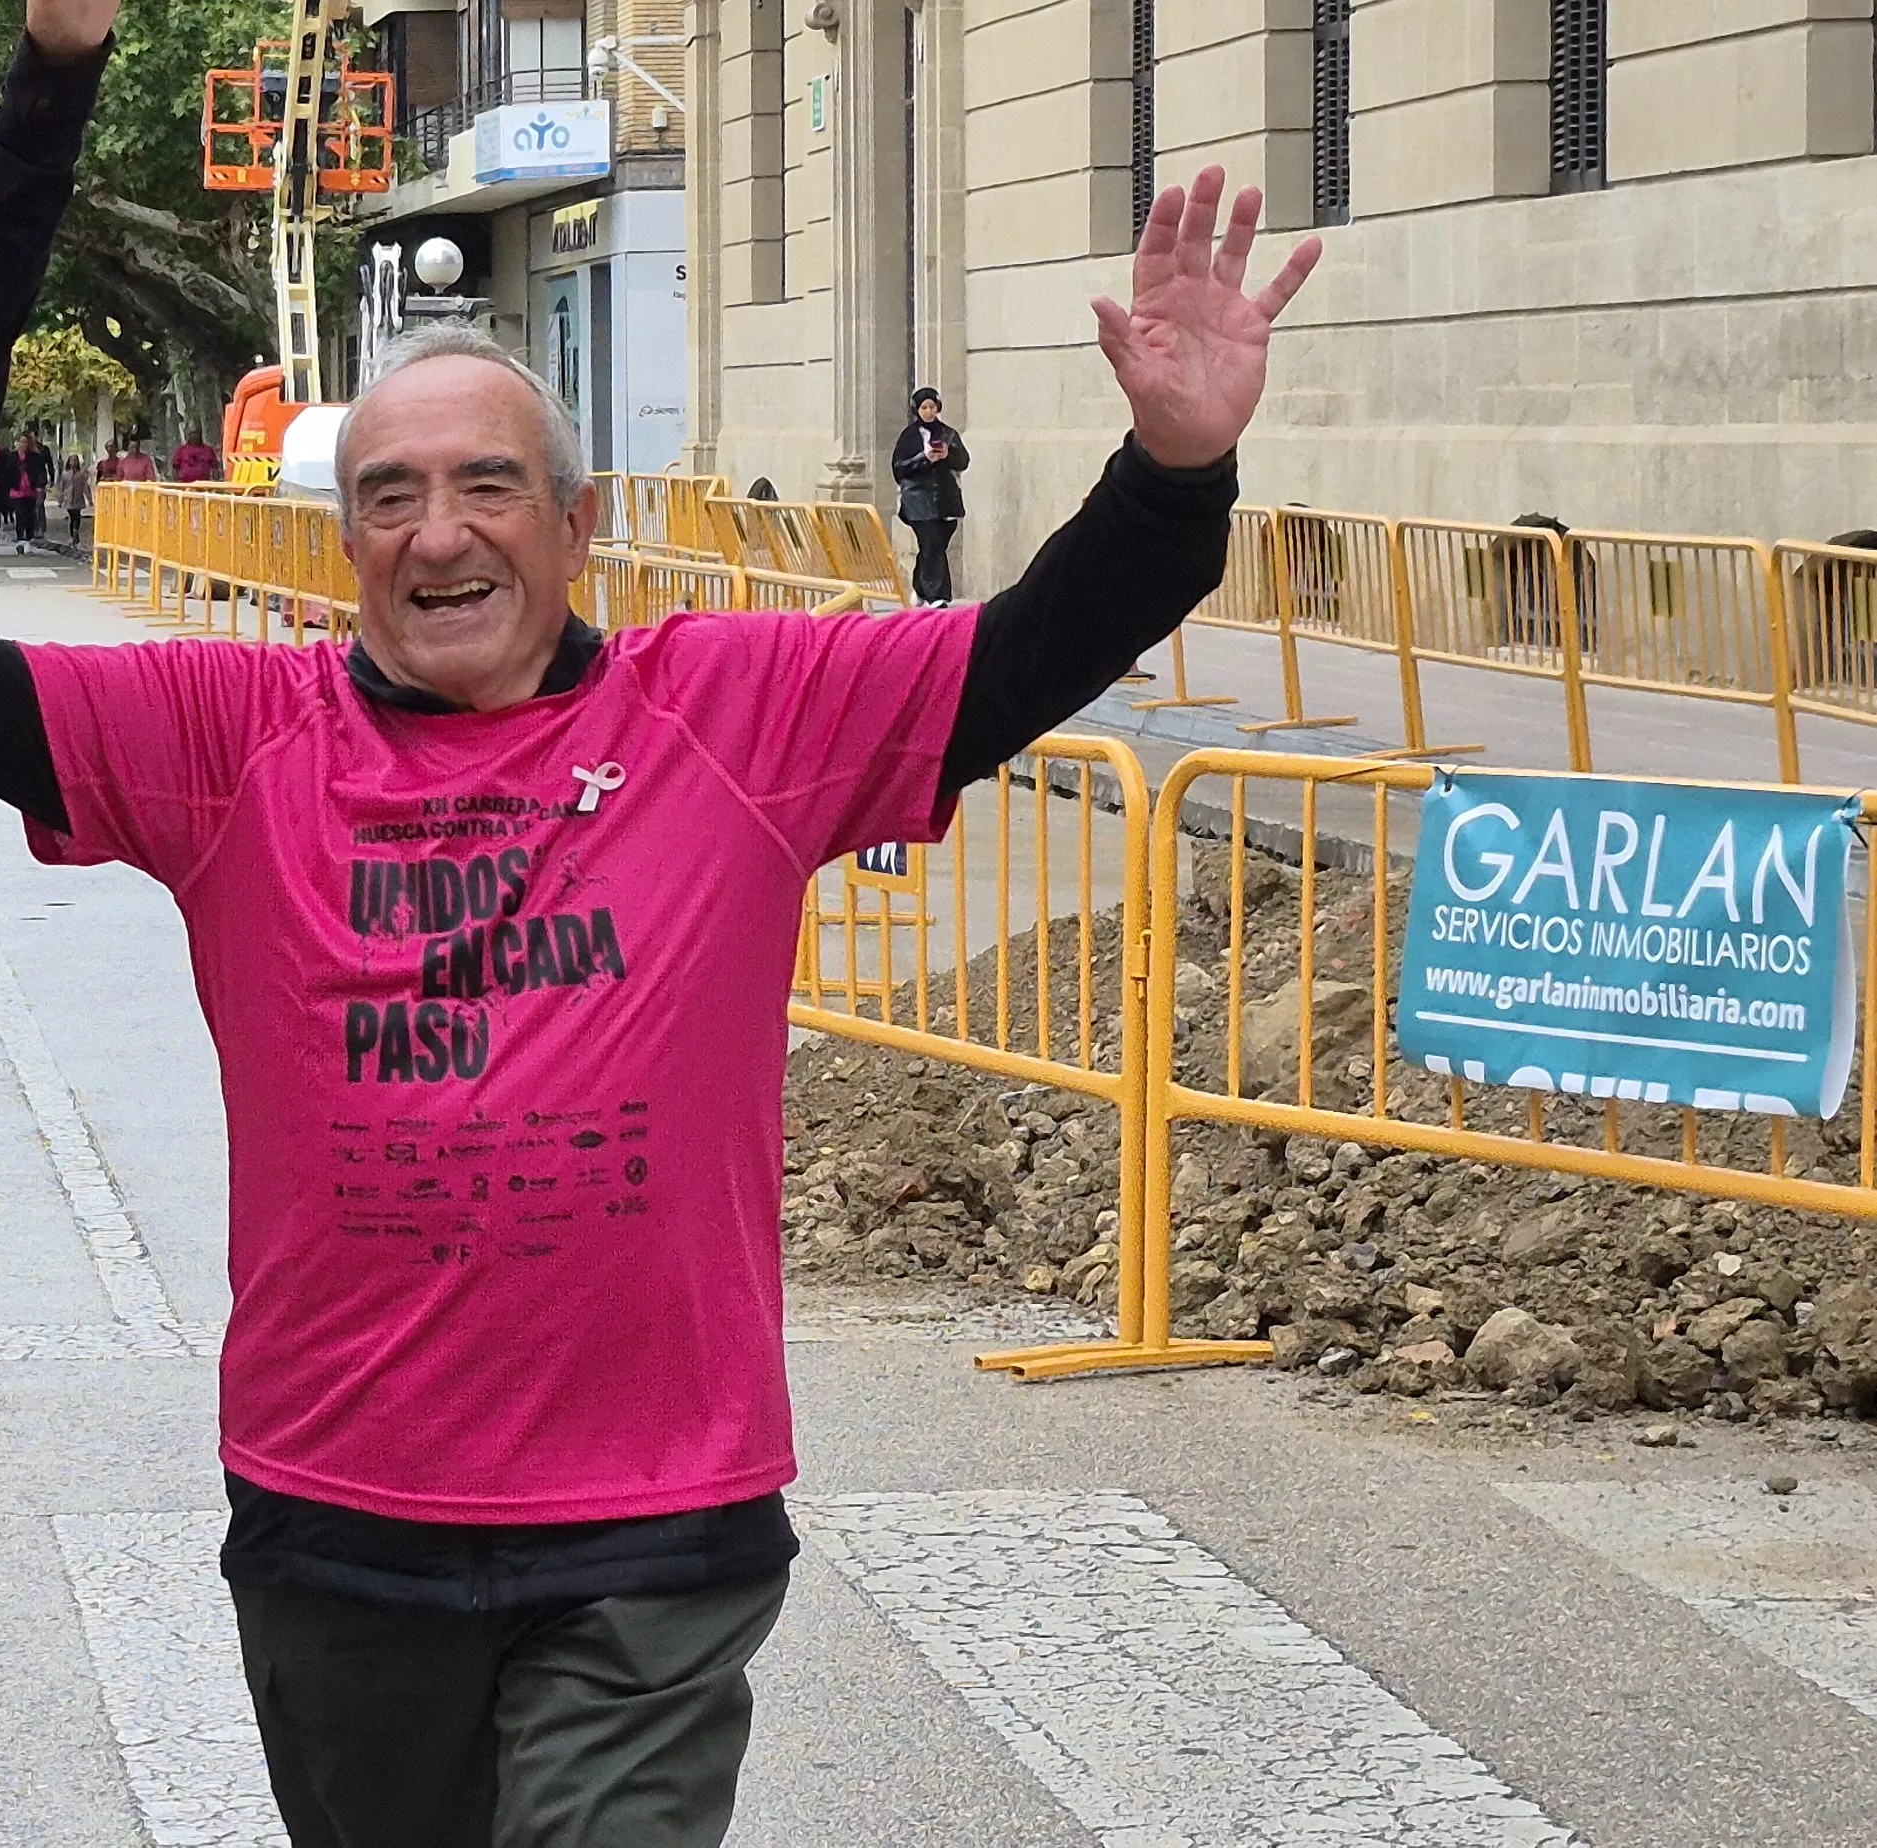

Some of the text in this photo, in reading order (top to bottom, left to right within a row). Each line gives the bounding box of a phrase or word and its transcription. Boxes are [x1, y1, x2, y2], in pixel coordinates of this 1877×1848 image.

[349, 845, 529, 936] UNIDOS
[1444, 802, 1824, 929] GARLAN
[424, 908, 625, 998] EN CADA
[1432, 905, 1812, 976] SERVICIOS INMOBILIARIOS
[345, 1001, 489, 1083] PASO
[1425, 966, 1806, 1032] www.garlaninmobiliaria.com
